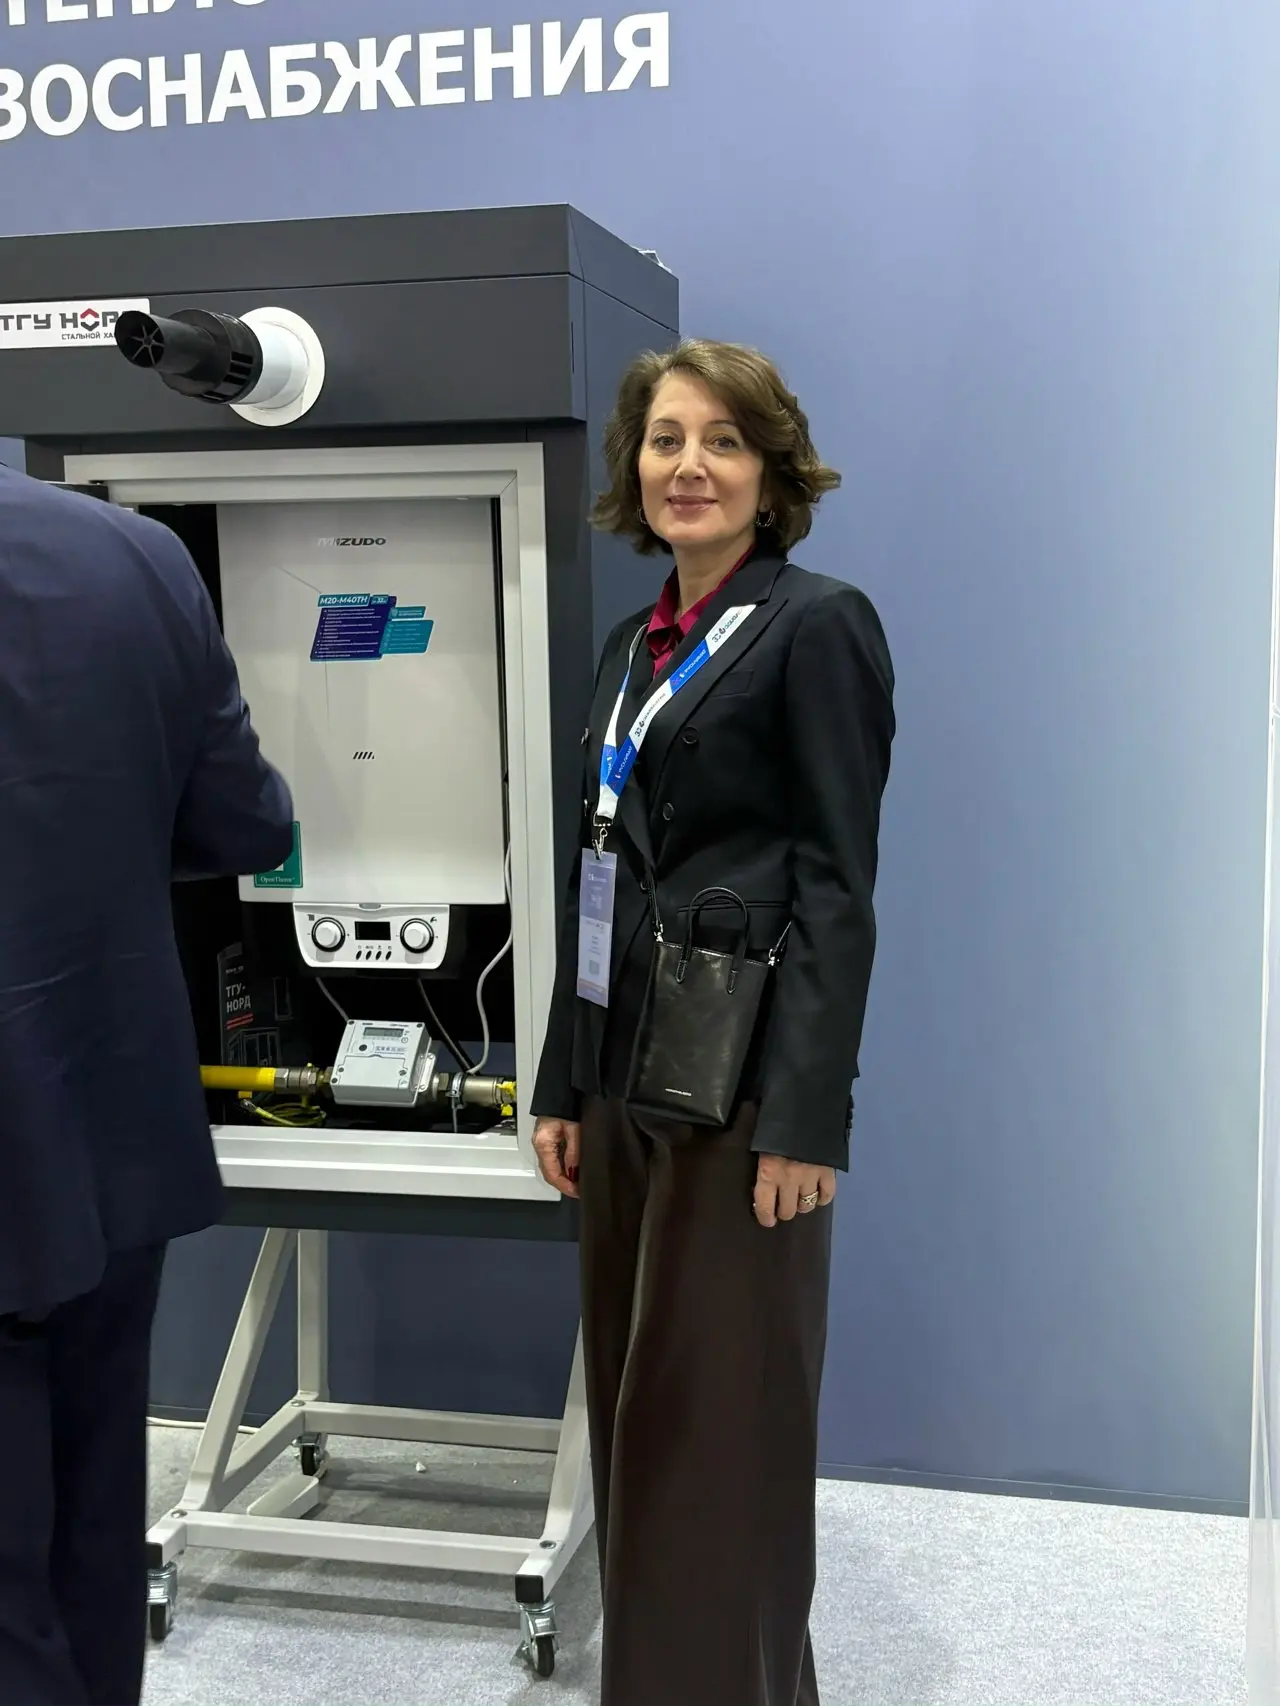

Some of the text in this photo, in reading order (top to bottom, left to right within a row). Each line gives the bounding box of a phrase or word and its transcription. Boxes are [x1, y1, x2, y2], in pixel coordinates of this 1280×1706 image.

[0, 308, 128, 332] ТГУ НОР
[61, 331, 101, 341] СТАЛЬНОЙ
[317, 537, 387, 547] MIZUDO
[226, 995, 252, 1014] НОРД
